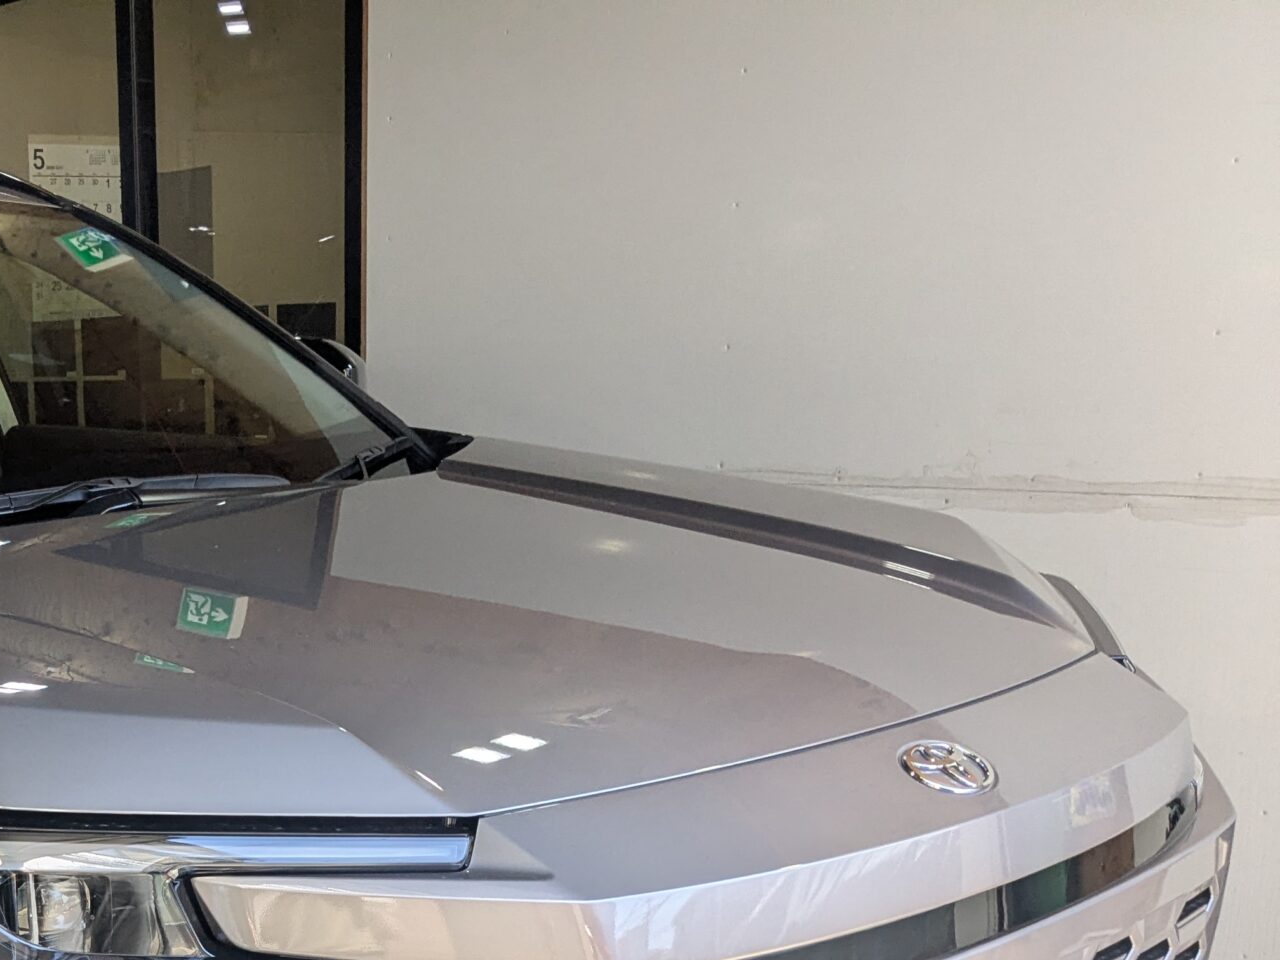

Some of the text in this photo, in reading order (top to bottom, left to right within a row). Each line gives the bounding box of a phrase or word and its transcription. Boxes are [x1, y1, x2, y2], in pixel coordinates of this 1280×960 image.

[33, 148, 45, 170] 5
[106, 178, 111, 189] 1
[106, 203, 112, 214] 8
[51, 280, 63, 292] 25
